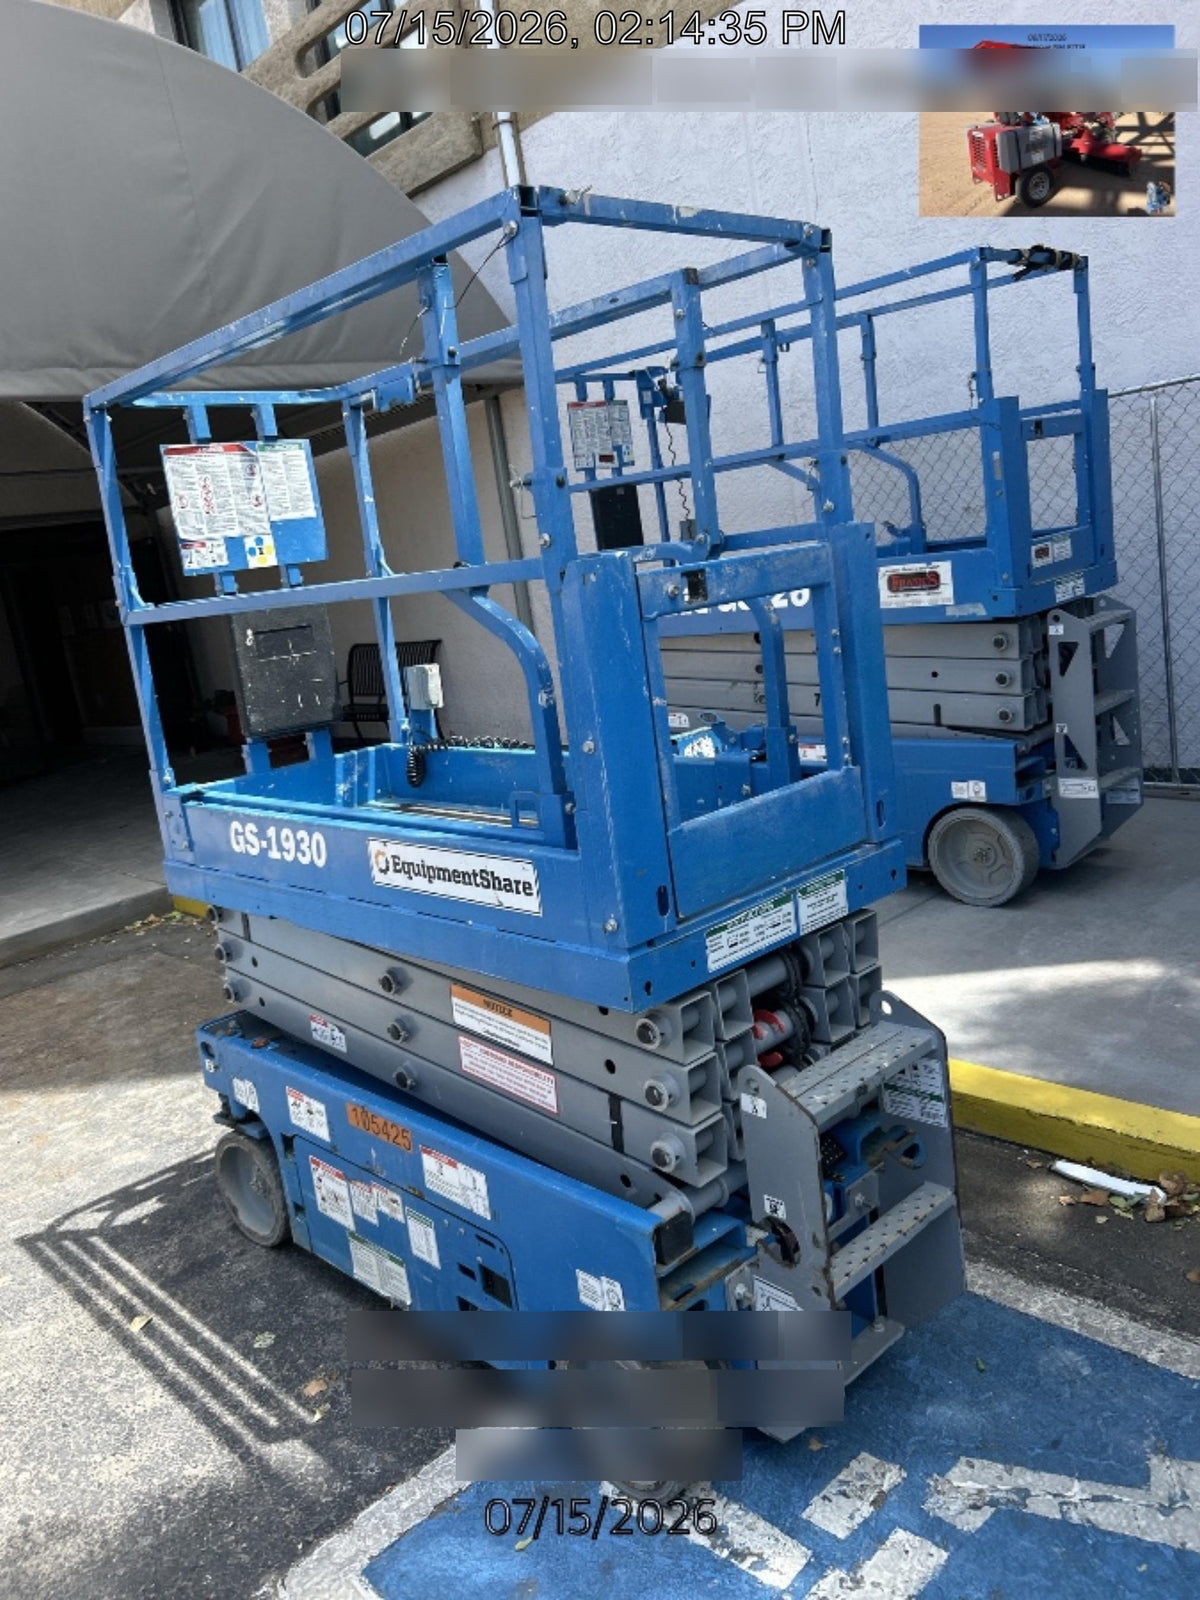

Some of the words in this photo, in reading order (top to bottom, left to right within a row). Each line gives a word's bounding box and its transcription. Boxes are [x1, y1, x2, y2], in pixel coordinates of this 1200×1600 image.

[229, 820, 327, 868] GS-1930
[391, 854, 534, 897] EquipmentShare
[351, 1105, 412, 1151] 105425
